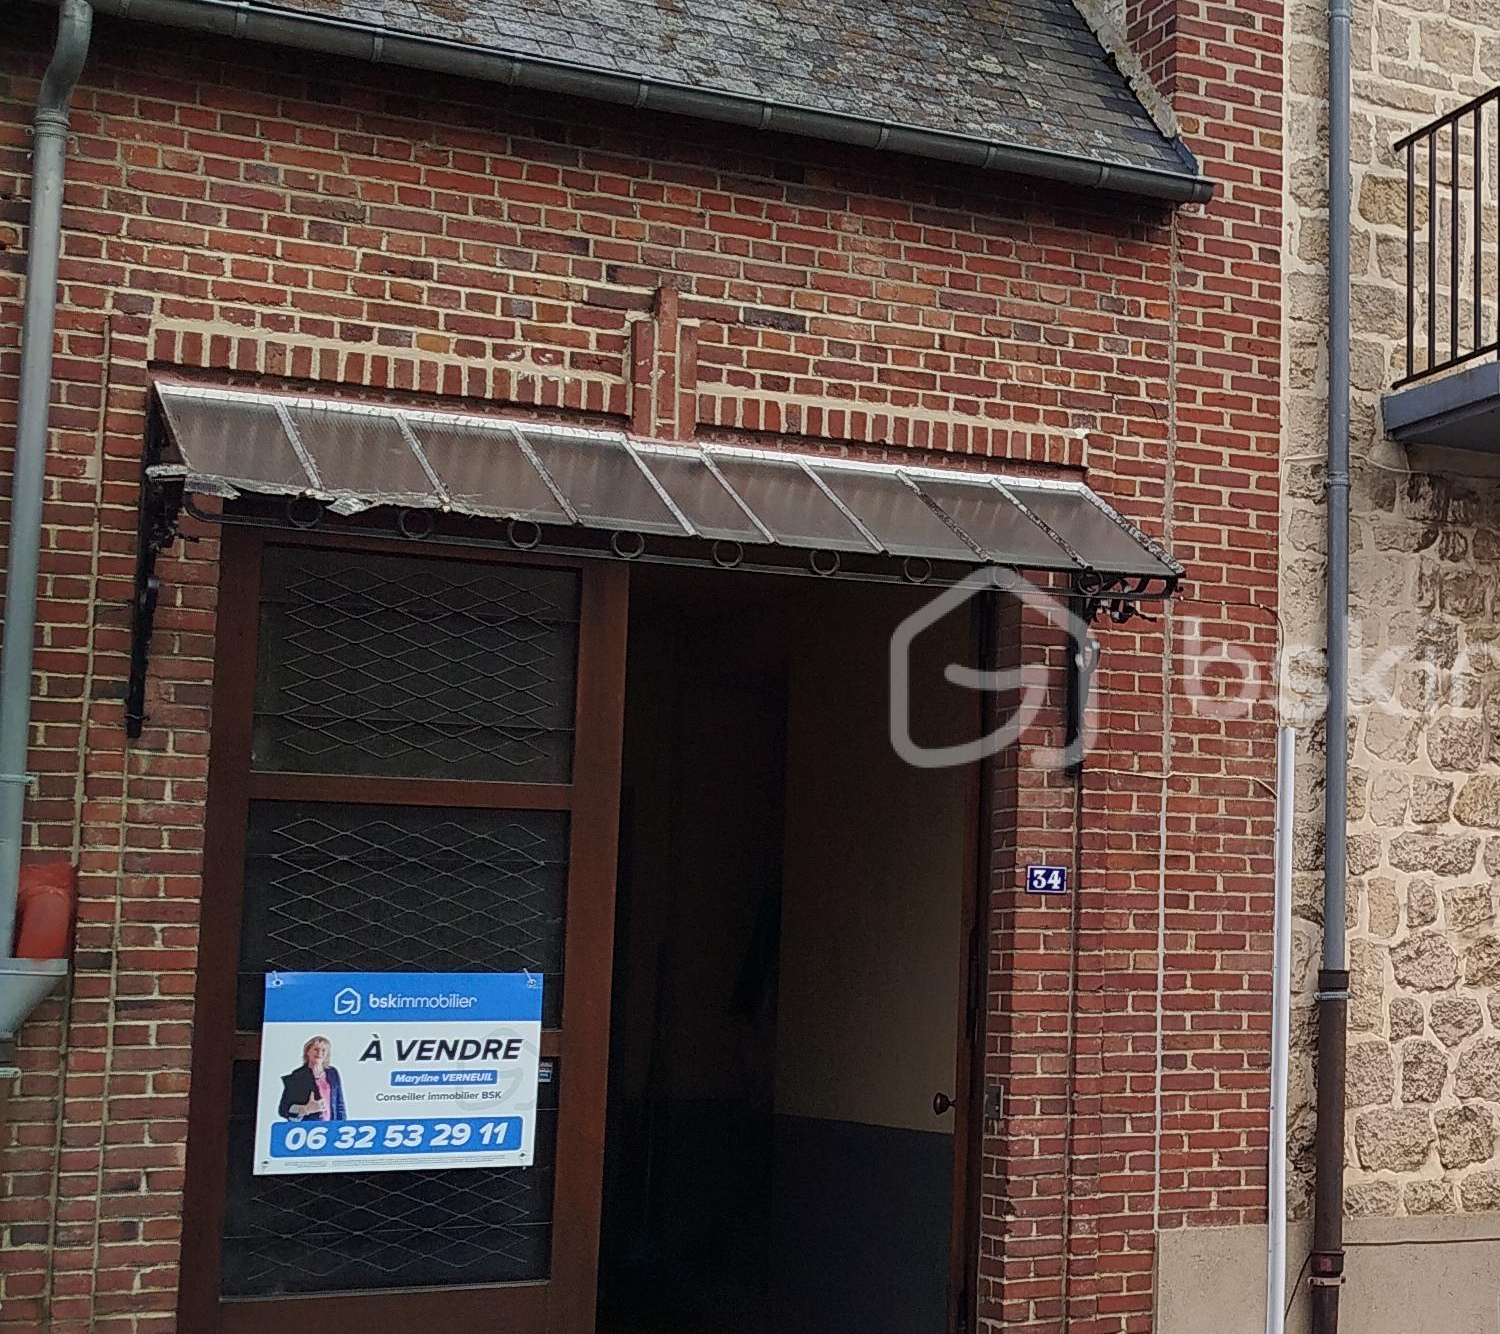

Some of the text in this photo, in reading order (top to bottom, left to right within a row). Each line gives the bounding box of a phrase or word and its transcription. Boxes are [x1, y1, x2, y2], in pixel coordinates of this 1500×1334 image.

[1032, 869, 1061, 889] 34
[369, 993, 478, 1009] bskimmobilier
[359, 1033, 523, 1062] À VENDRE
[395, 1072, 493, 1084] Maryline VERNEUIL
[376, 1090, 502, 1102] Conseiller immobilier BSK
[285, 1121, 509, 1150] 06 32 53 29 11
